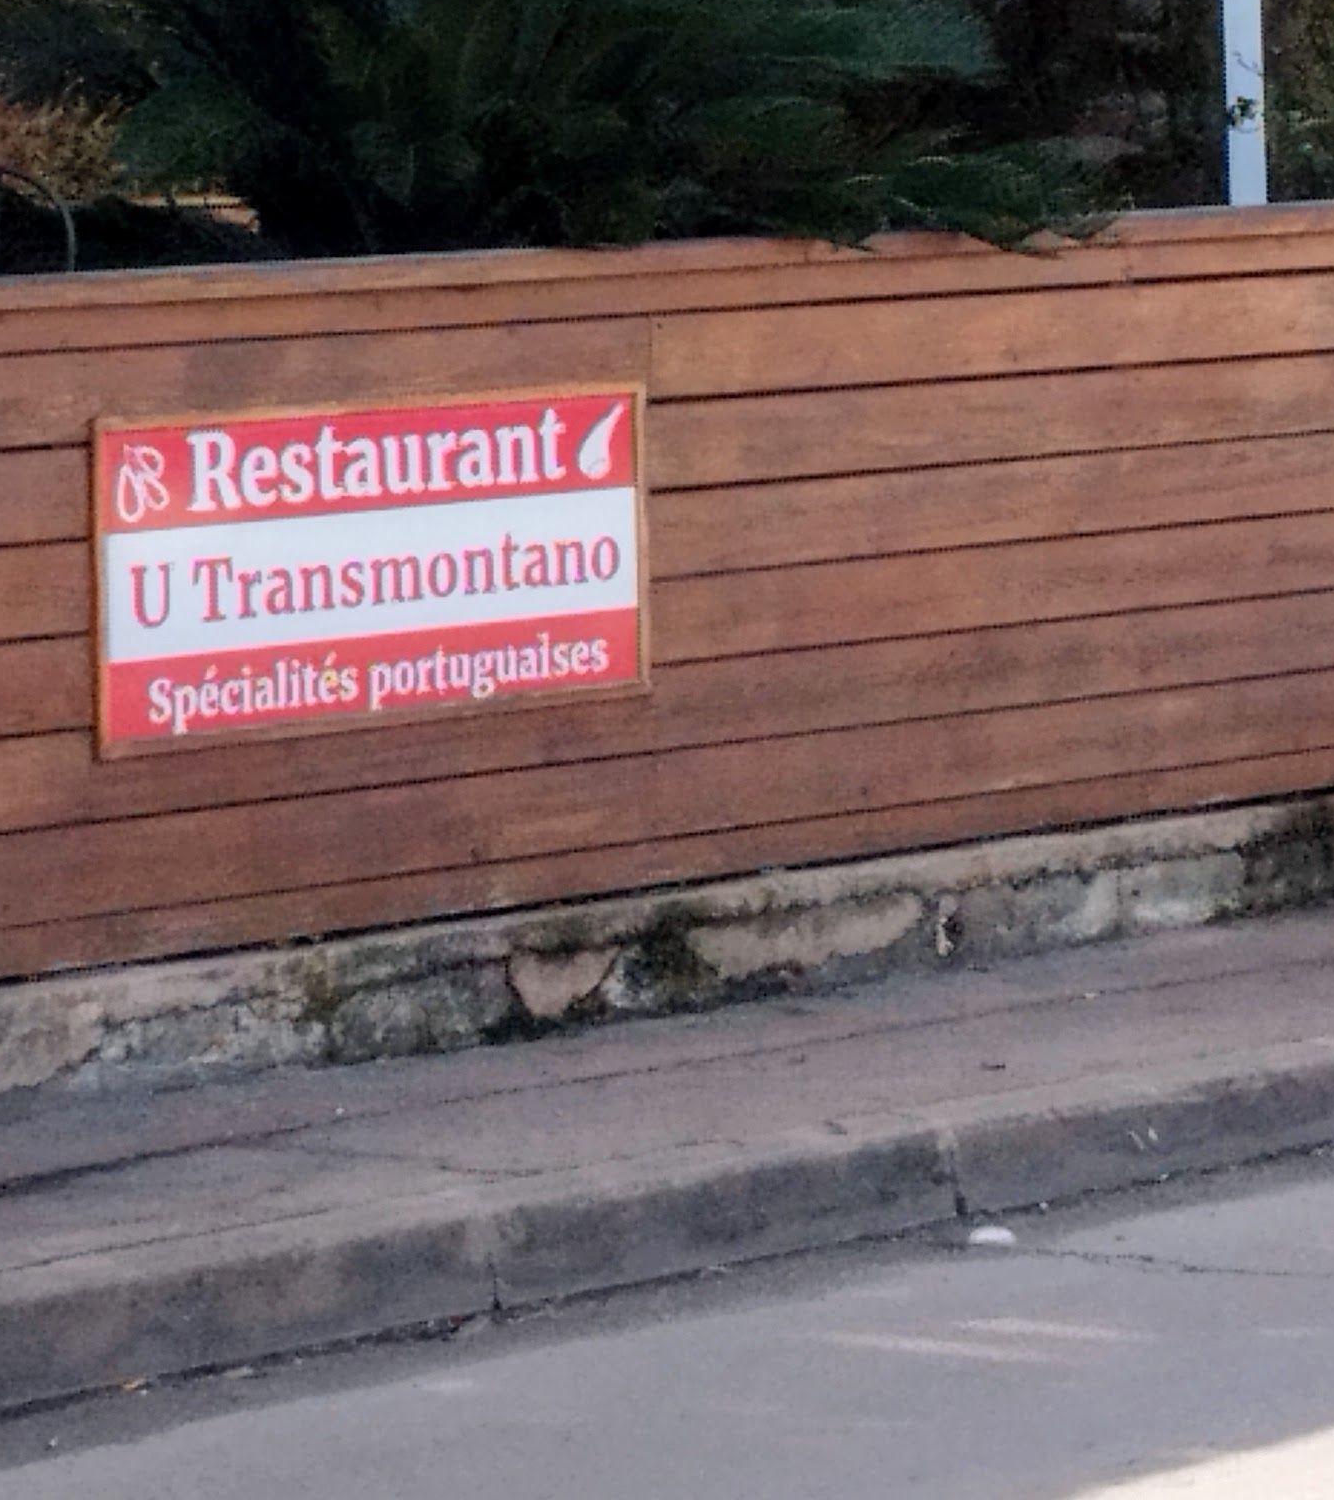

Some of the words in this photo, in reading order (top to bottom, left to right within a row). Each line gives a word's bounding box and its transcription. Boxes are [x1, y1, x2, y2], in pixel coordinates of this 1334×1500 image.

[186, 406, 567, 512] Restaurant
[128, 560, 171, 629] U
[190, 531, 621, 623] Transmontano
[147, 650, 359, 736] Spécialités
[368, 630, 609, 712] portuguaises
